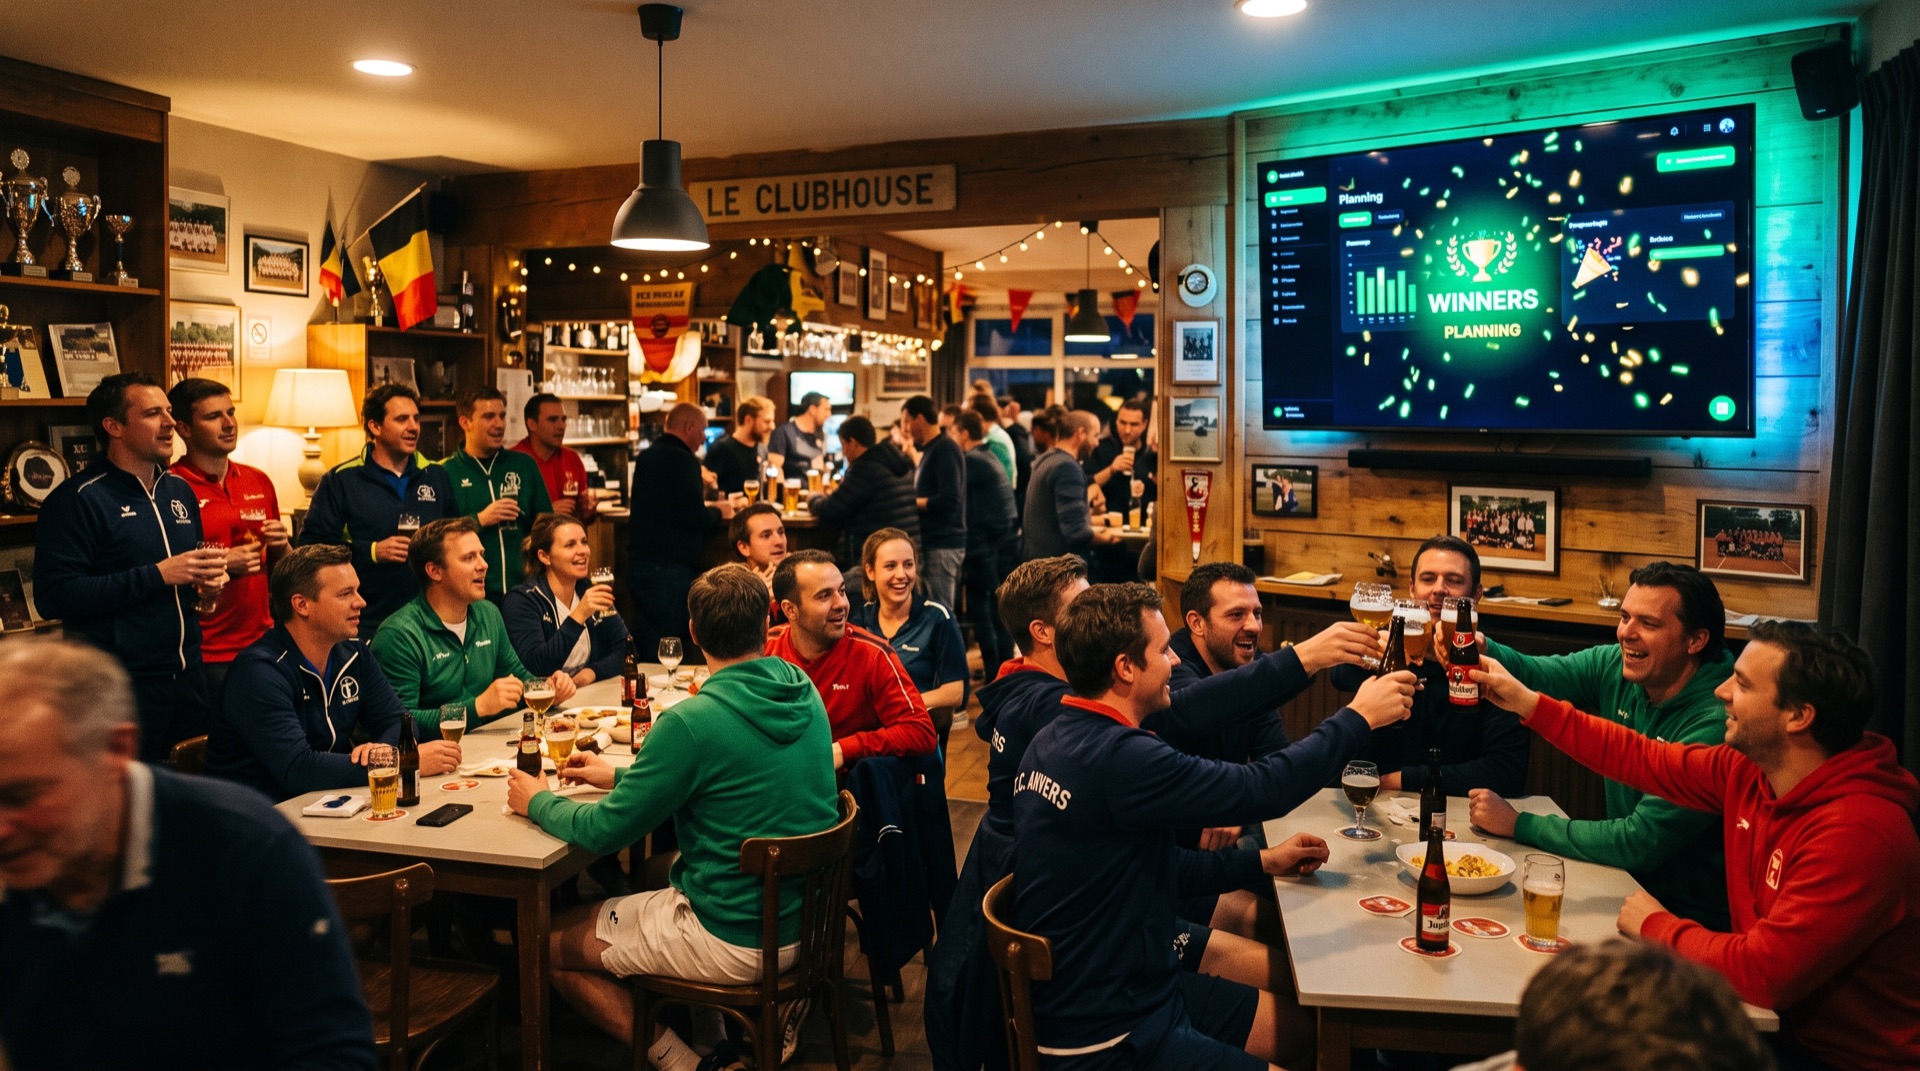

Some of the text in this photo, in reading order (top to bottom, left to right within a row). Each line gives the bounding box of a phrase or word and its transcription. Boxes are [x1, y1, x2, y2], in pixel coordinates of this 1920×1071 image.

[707, 174, 933, 217] LE CLUBHOUSE
[1338, 191, 1384, 205] Planning
[1427, 288, 1539, 314] WINNERS
[1444, 323, 1521, 340] PLANNING
[1027, 770, 1072, 810] ANVERS
